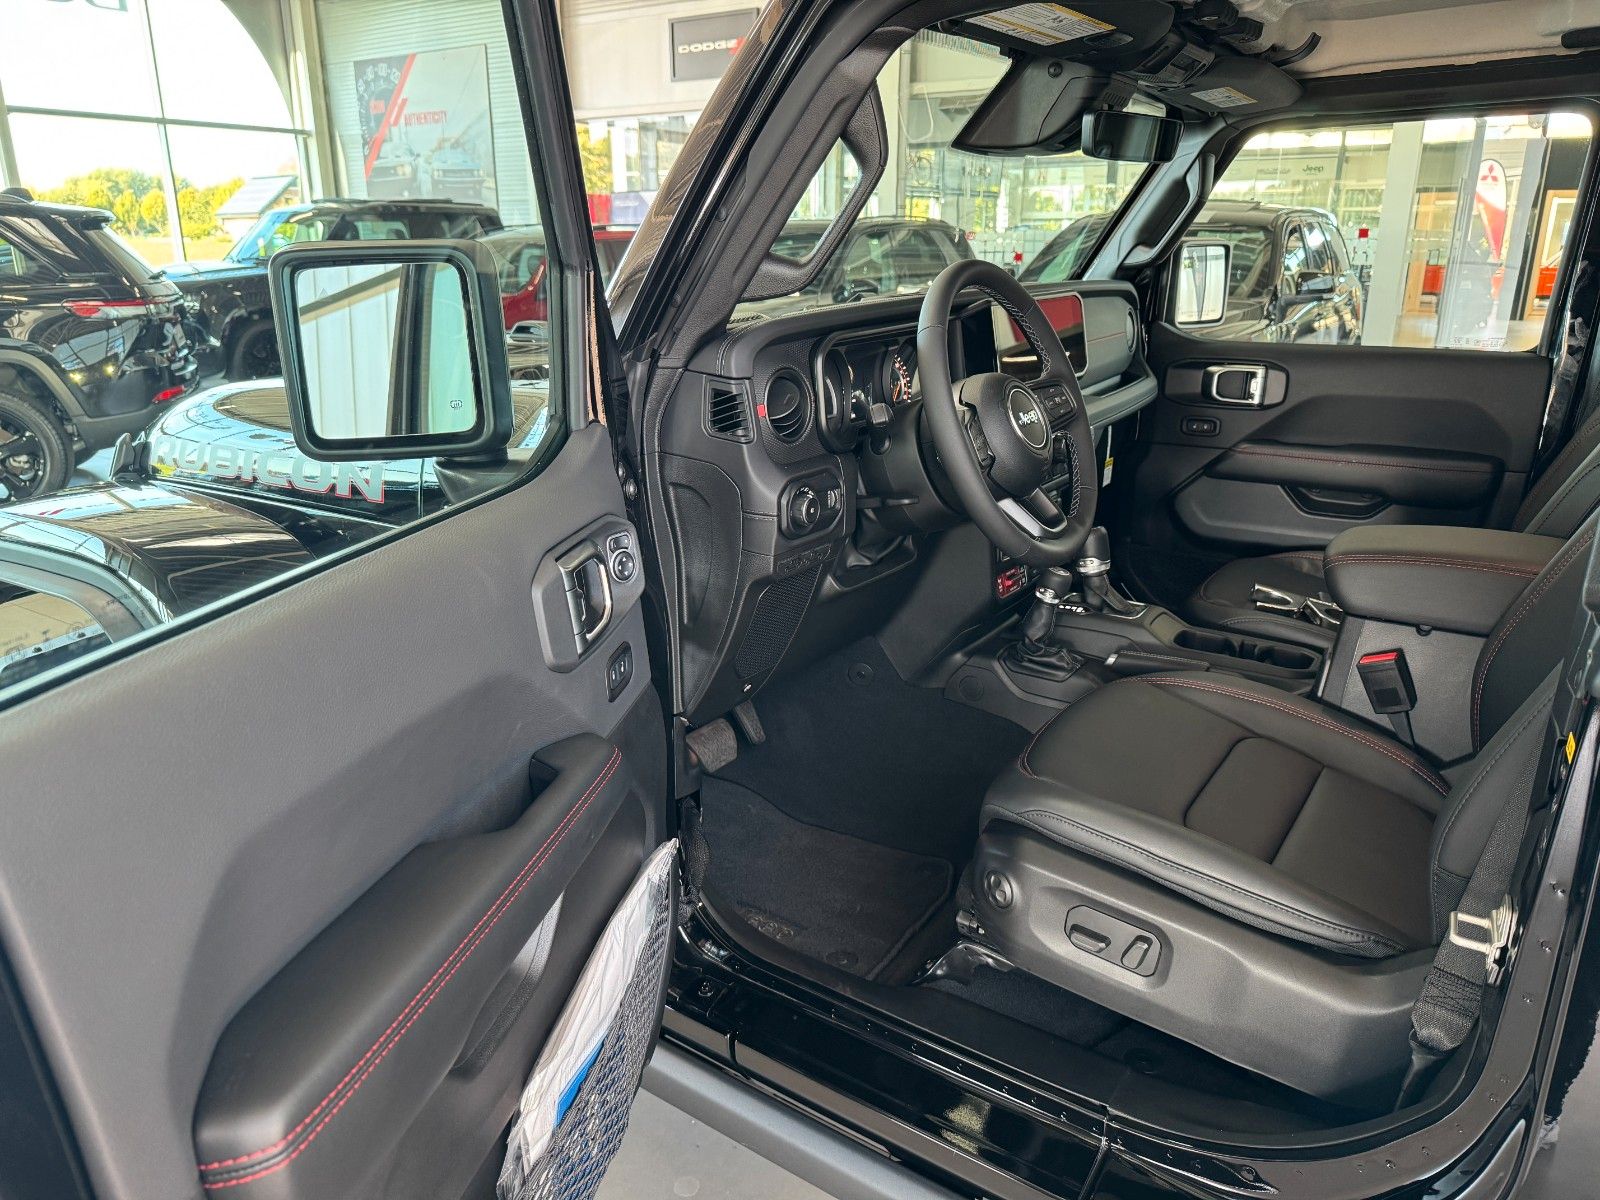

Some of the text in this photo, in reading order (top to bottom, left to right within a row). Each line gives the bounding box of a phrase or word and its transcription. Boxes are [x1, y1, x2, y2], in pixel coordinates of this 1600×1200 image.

[678, 38, 738, 54] DODGE
[405, 110, 447, 127] AUTHENTICITY
[1018, 409, 1038, 426] Jeep
[151, 435, 384, 503] RUBICON
